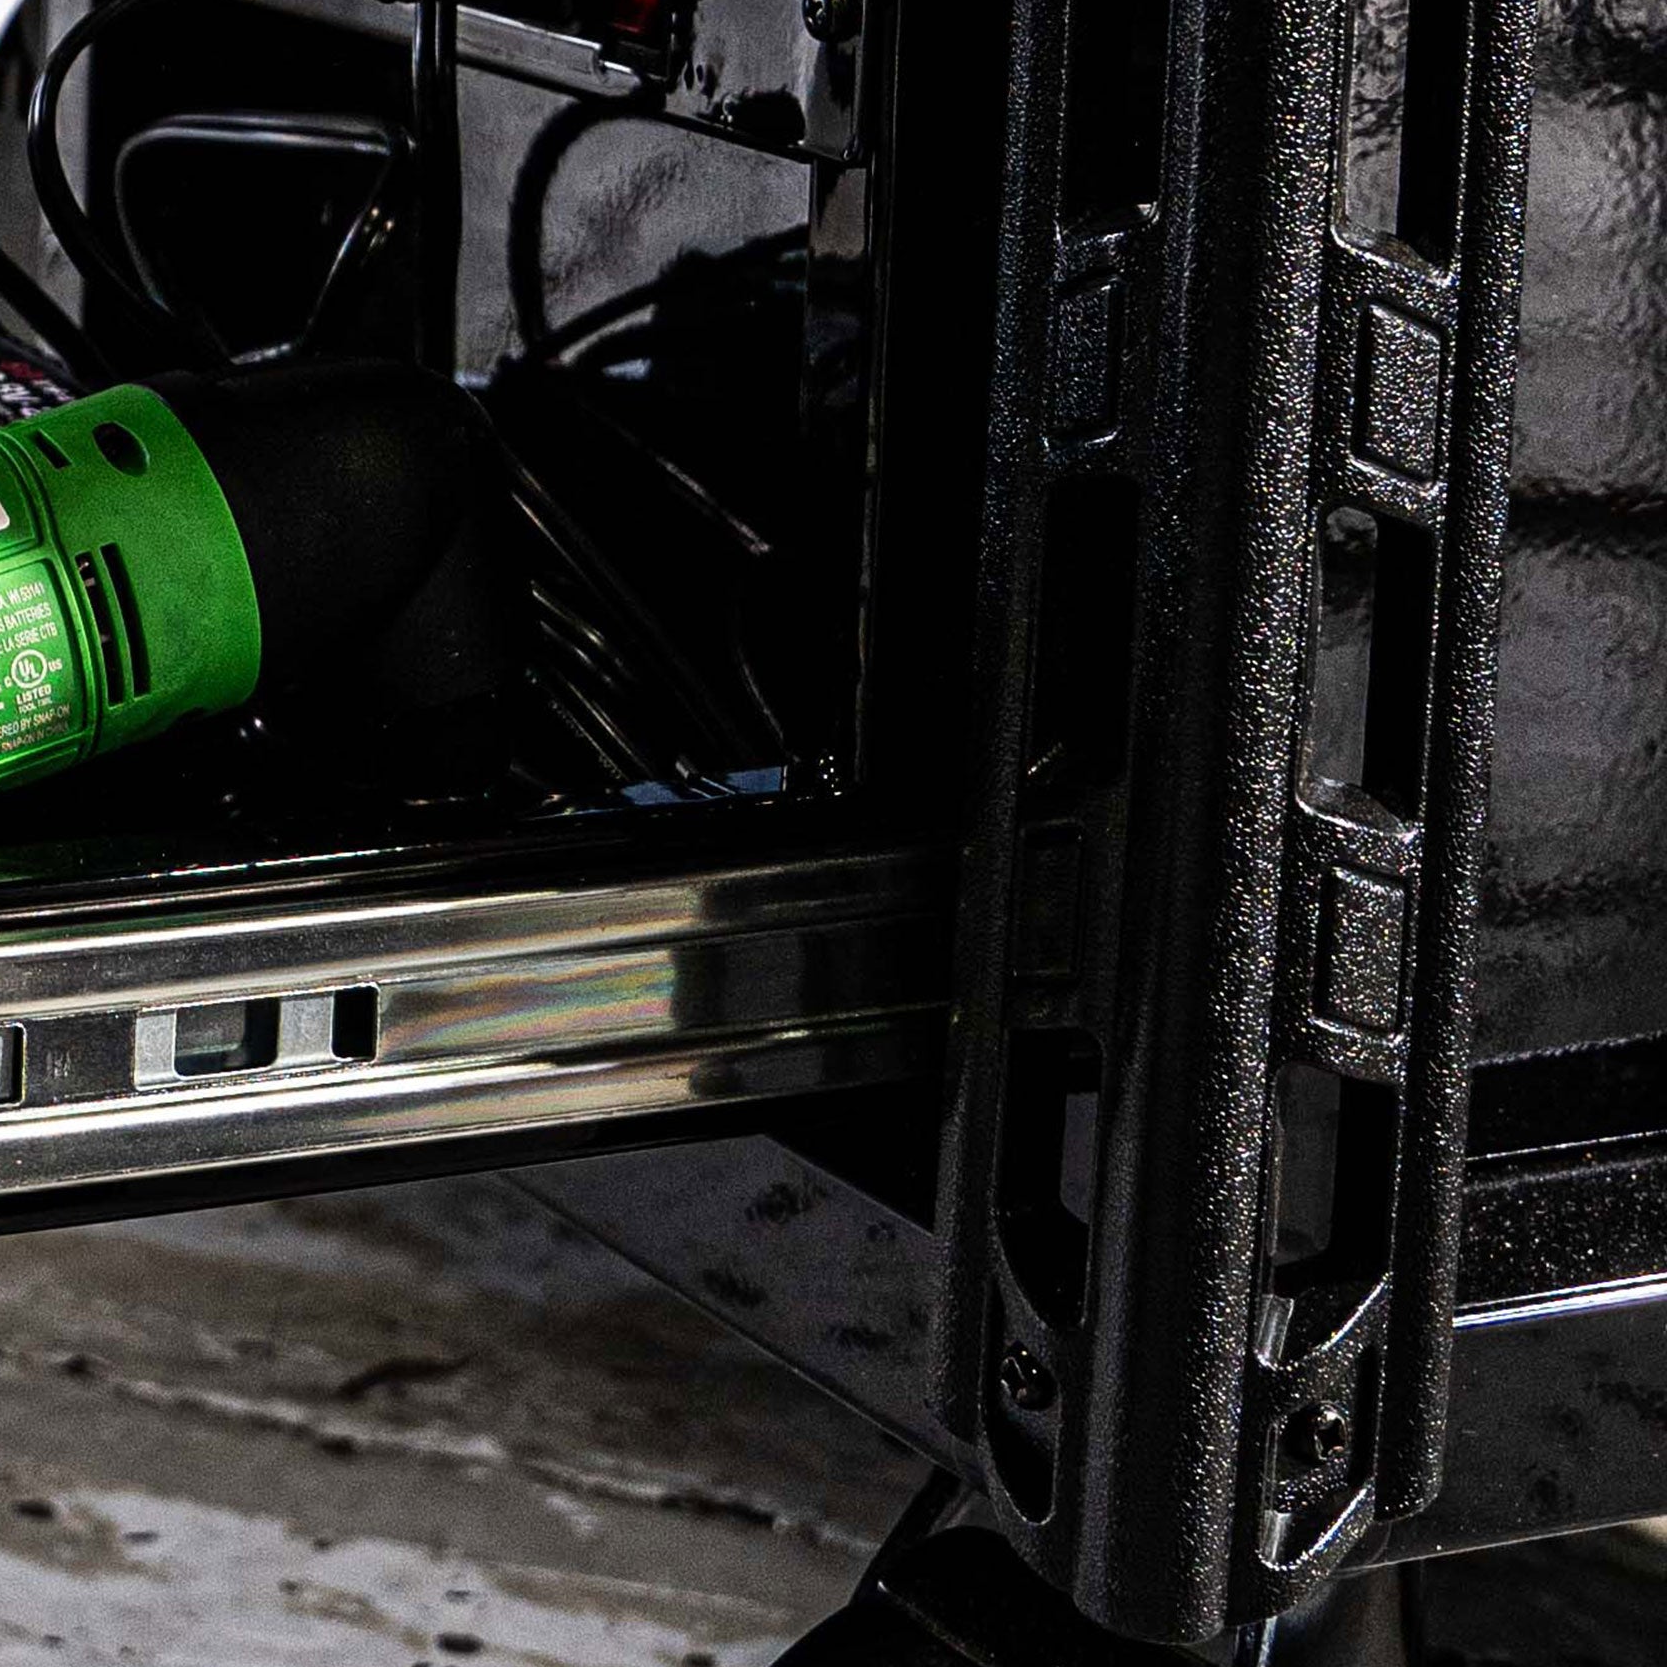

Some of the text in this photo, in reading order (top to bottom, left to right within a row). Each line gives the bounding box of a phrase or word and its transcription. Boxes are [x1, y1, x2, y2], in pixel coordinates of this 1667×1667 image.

[4, 602, 53, 632] BATTERIES
[3, 636, 16, 652] LA
[40, 622, 58, 641] CTB
[16, 684, 52, 705] LISTED
[19, 717, 33, 731] BY
